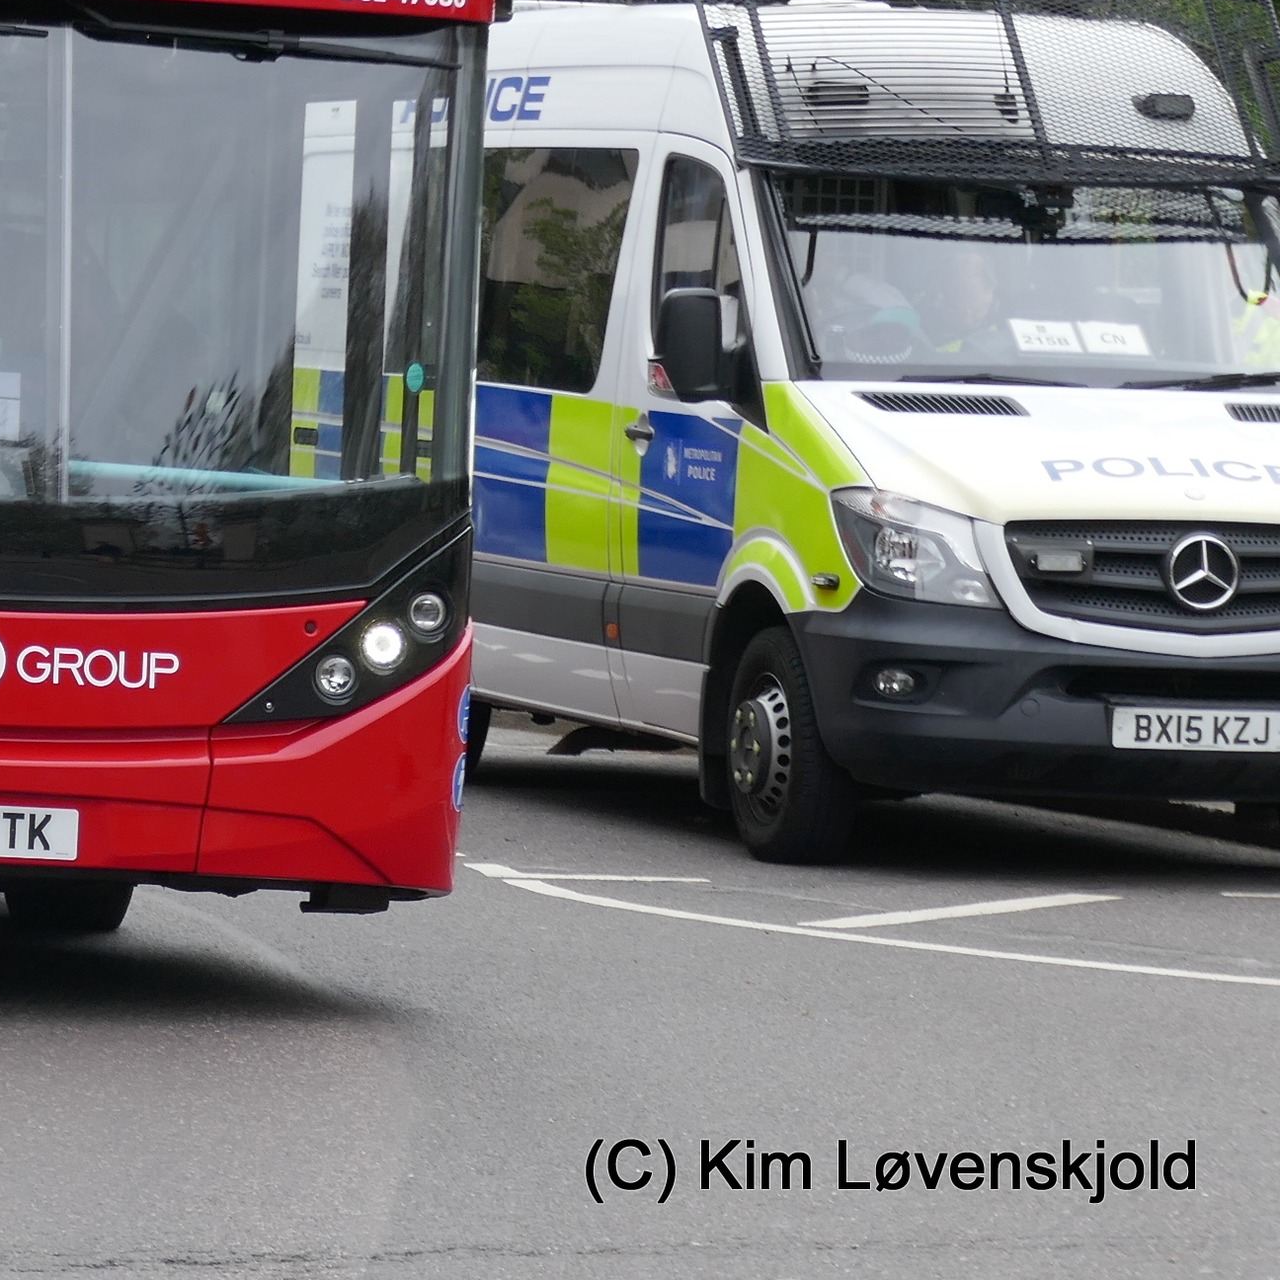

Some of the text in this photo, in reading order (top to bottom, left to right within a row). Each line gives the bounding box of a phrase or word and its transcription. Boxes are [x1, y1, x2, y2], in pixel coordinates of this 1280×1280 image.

[1100, 332, 1128, 346] CN
[687, 465, 716, 481] POLICE
[16, 645, 180, 689] GROUP
[1134, 714, 1270, 745] BX15 KZJ
